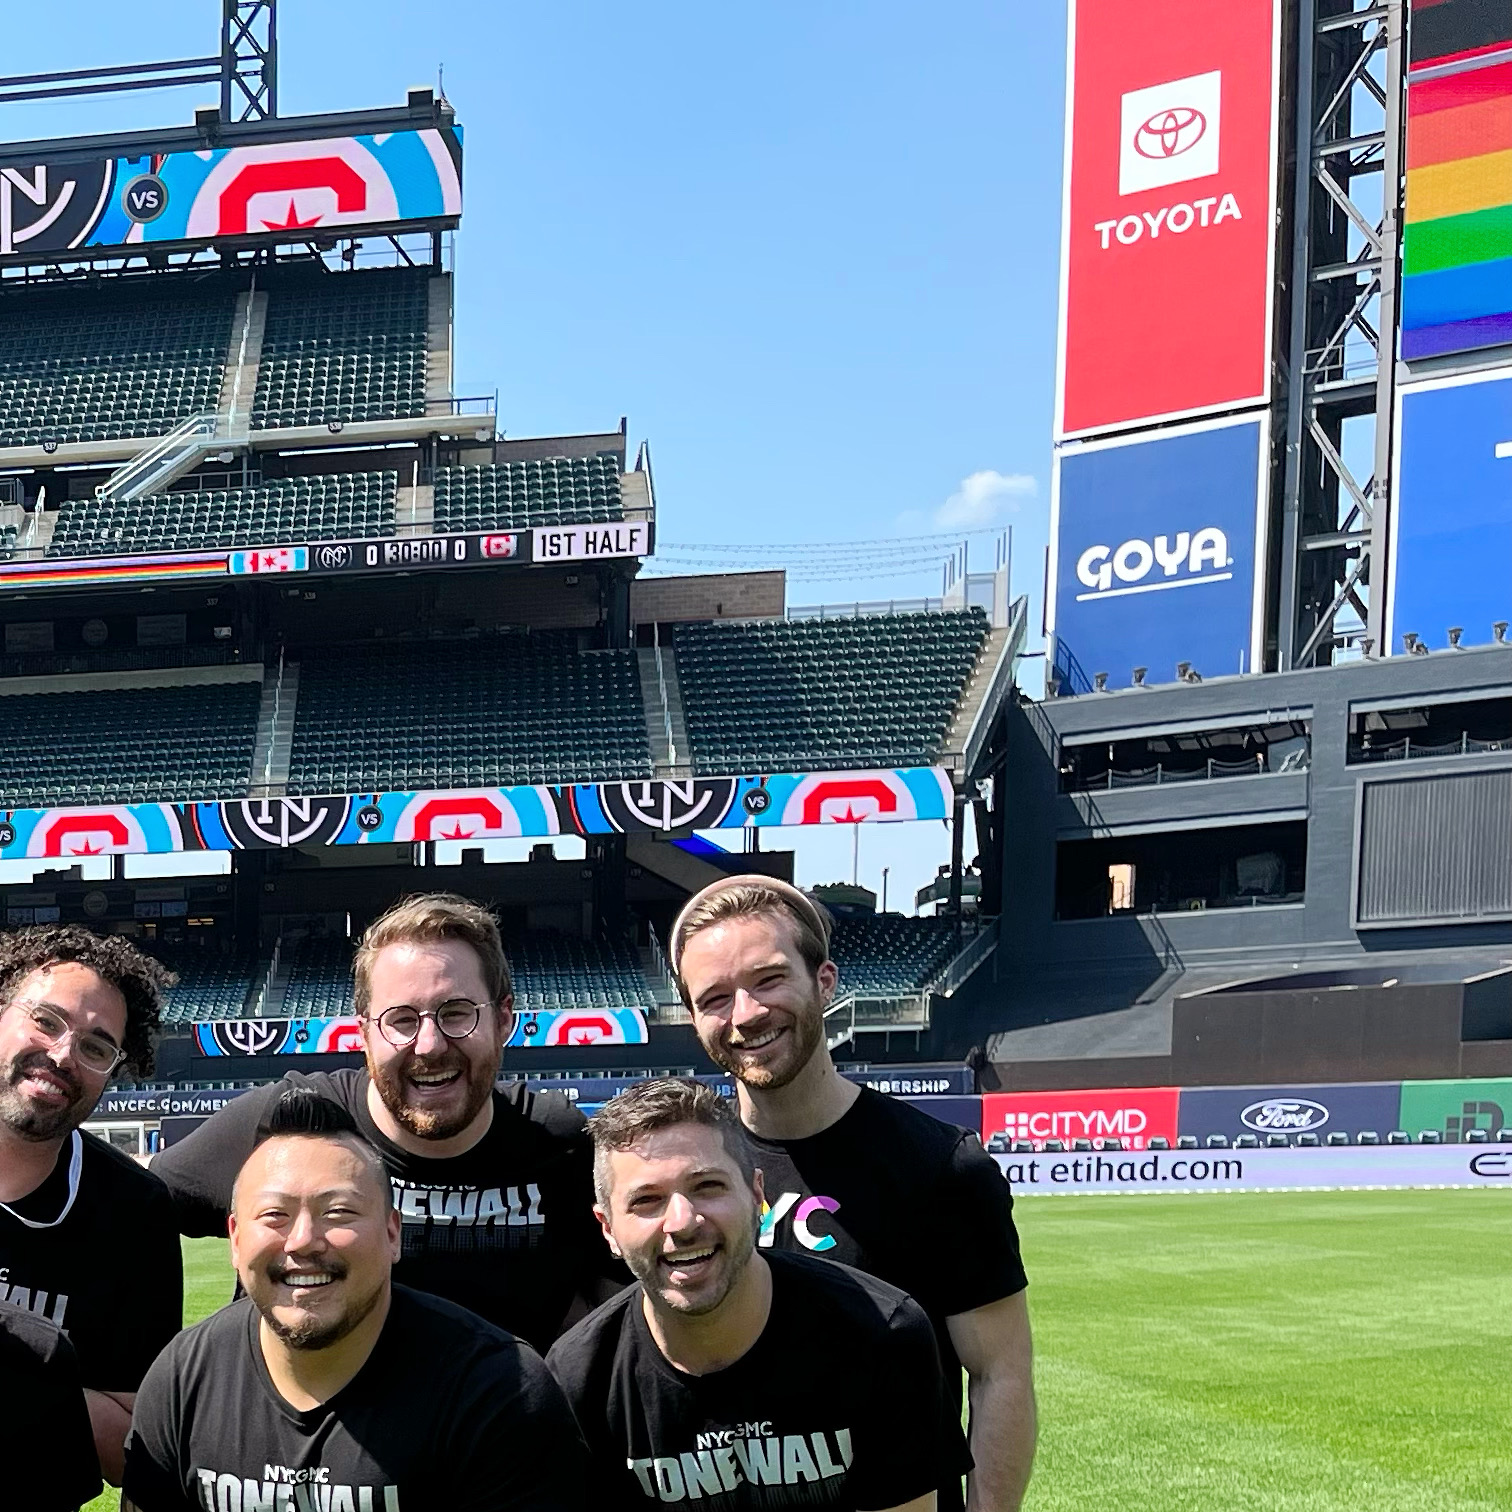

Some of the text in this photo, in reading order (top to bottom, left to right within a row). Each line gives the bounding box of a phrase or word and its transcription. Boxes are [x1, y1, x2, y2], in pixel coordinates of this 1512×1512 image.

[130, 191, 159, 208] VS
[1094, 193, 1243, 250] TOYOTA
[366, 545, 377, 566] 0
[388, 540, 445, 564] 30:00
[454, 540, 466, 560] 0
[542, 529, 642, 557] 1ST HALF
[1076, 527, 1228, 591] GOYA
[747, 796, 766, 809] VS
[360, 813, 381, 826] VS
[1029, 1109, 1147, 1136] CITYMD
[1256, 1103, 1314, 1128] Ford
[1006, 1156, 1242, 1183] at etihad.com
[759, 1192, 841, 1252] YC
